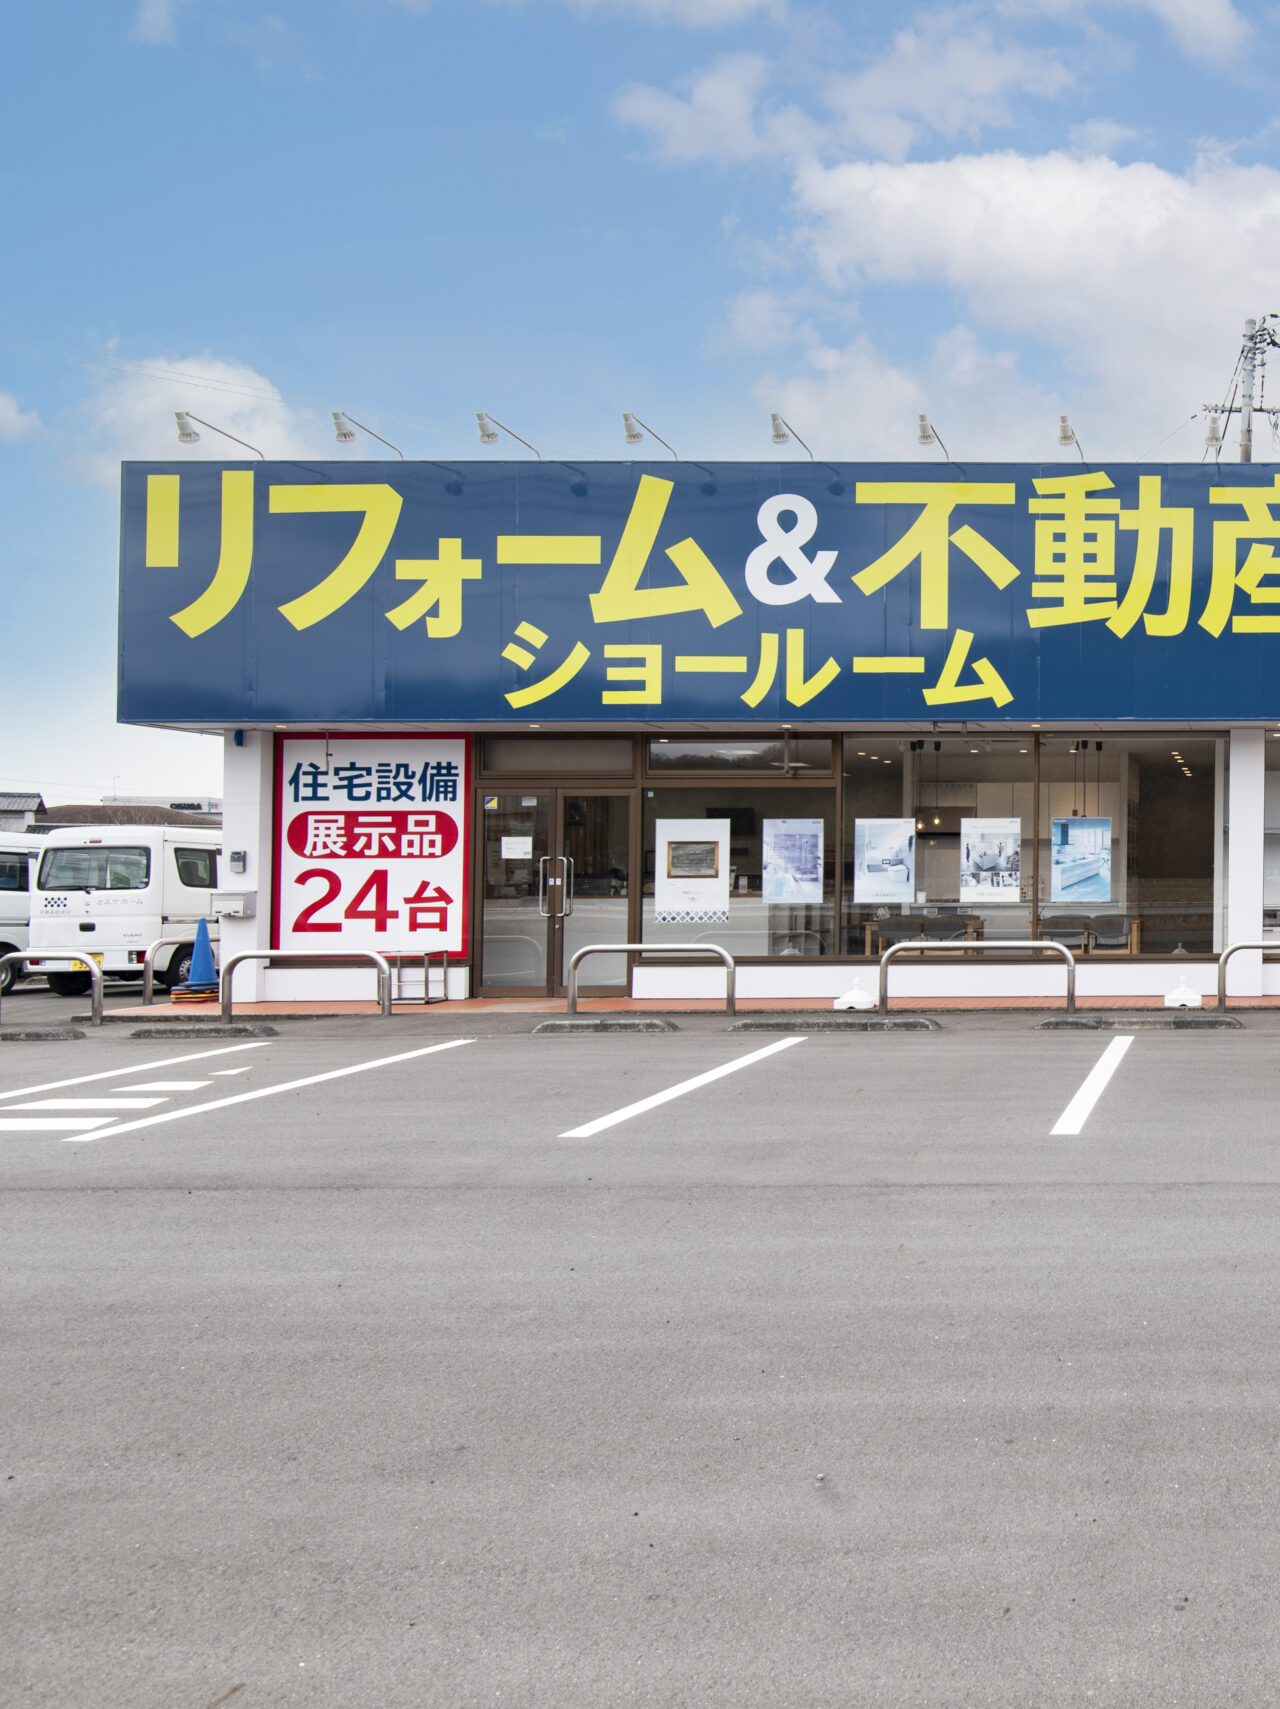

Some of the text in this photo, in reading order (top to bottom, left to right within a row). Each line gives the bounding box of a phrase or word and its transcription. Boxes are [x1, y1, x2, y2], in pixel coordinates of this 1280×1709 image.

[502, 621, 1014, 709] ショールーム
[288, 761, 459, 803] 住宅設備
[303, 814, 443, 857] 展示品
[292, 868, 455, 933] 24台
